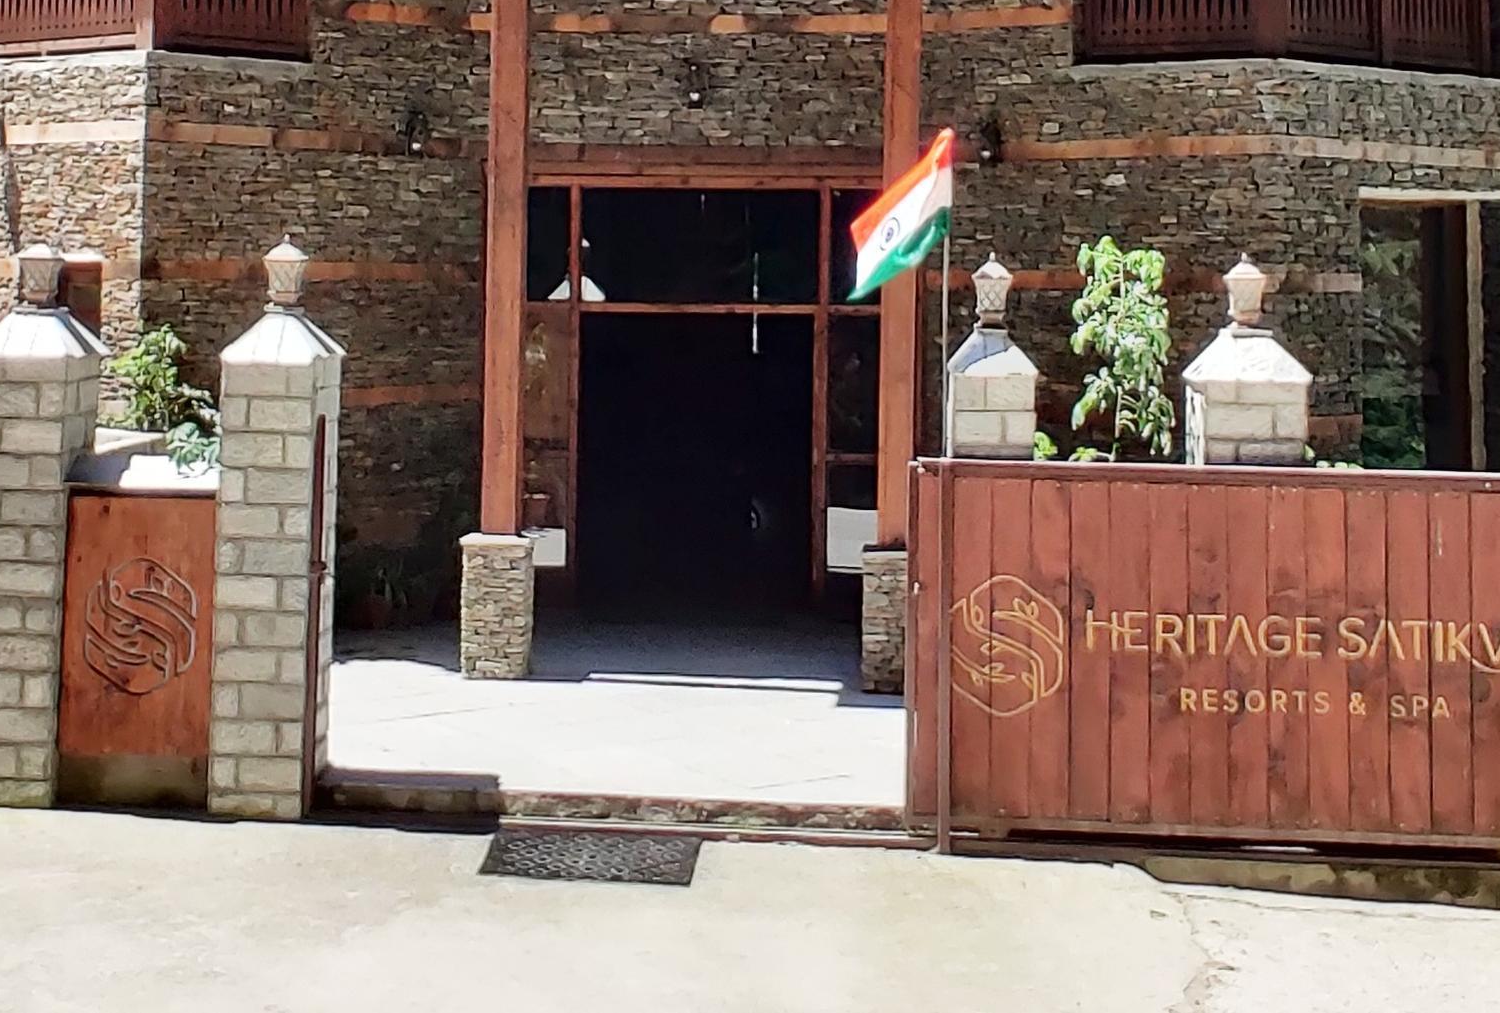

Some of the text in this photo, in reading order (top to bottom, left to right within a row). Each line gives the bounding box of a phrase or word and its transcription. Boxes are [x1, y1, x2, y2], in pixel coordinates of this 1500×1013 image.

[1084, 609, 1323, 659] HERITAGE
[1179, 687, 1450, 718] RESORTS & SPA
